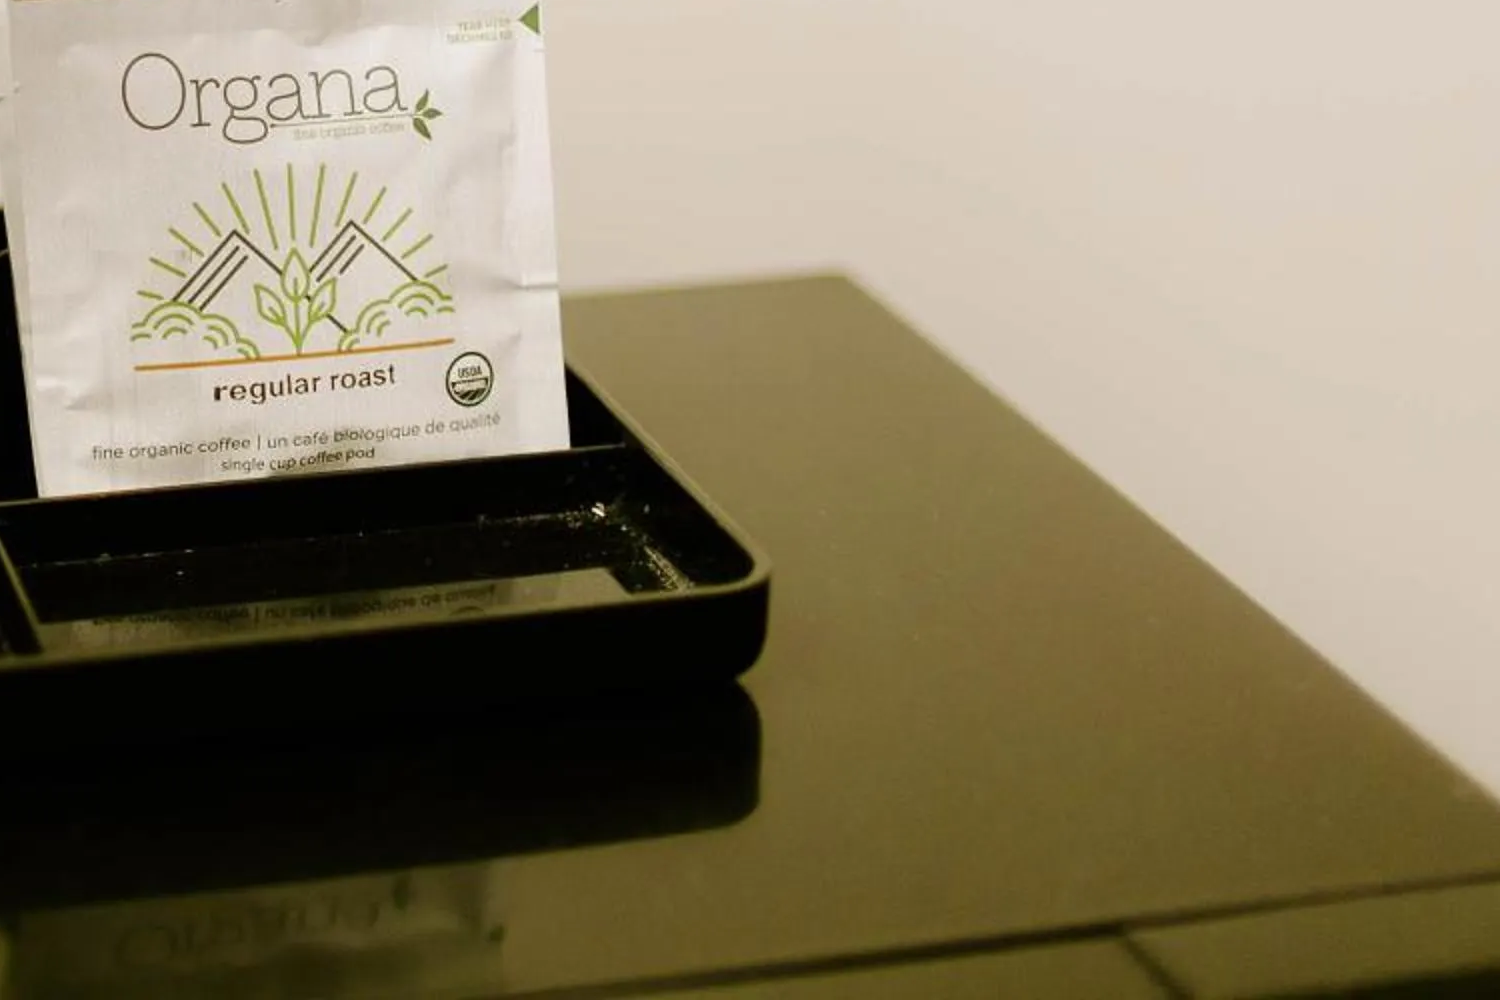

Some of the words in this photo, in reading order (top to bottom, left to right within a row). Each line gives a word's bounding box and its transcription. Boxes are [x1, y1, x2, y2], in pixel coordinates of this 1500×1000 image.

[121, 52, 408, 145] Organa
[213, 374, 322, 405] regular
[330, 364, 396, 390] roast
[457, 366, 483, 379] USDA
[93, 445, 125, 461] fine
[129, 441, 194, 460] organic
[197, 436, 251, 454] coffee
[267, 437, 289, 449] un
[293, 430, 329, 447] café
[333, 423, 421, 444] biologique
[425, 419, 445, 435] de
[450, 411, 501, 433] qualité
[222, 457, 266, 473] single
[269, 456, 297, 471] cup
[300, 448, 344, 466] coffee
[346, 446, 376, 464] pod
